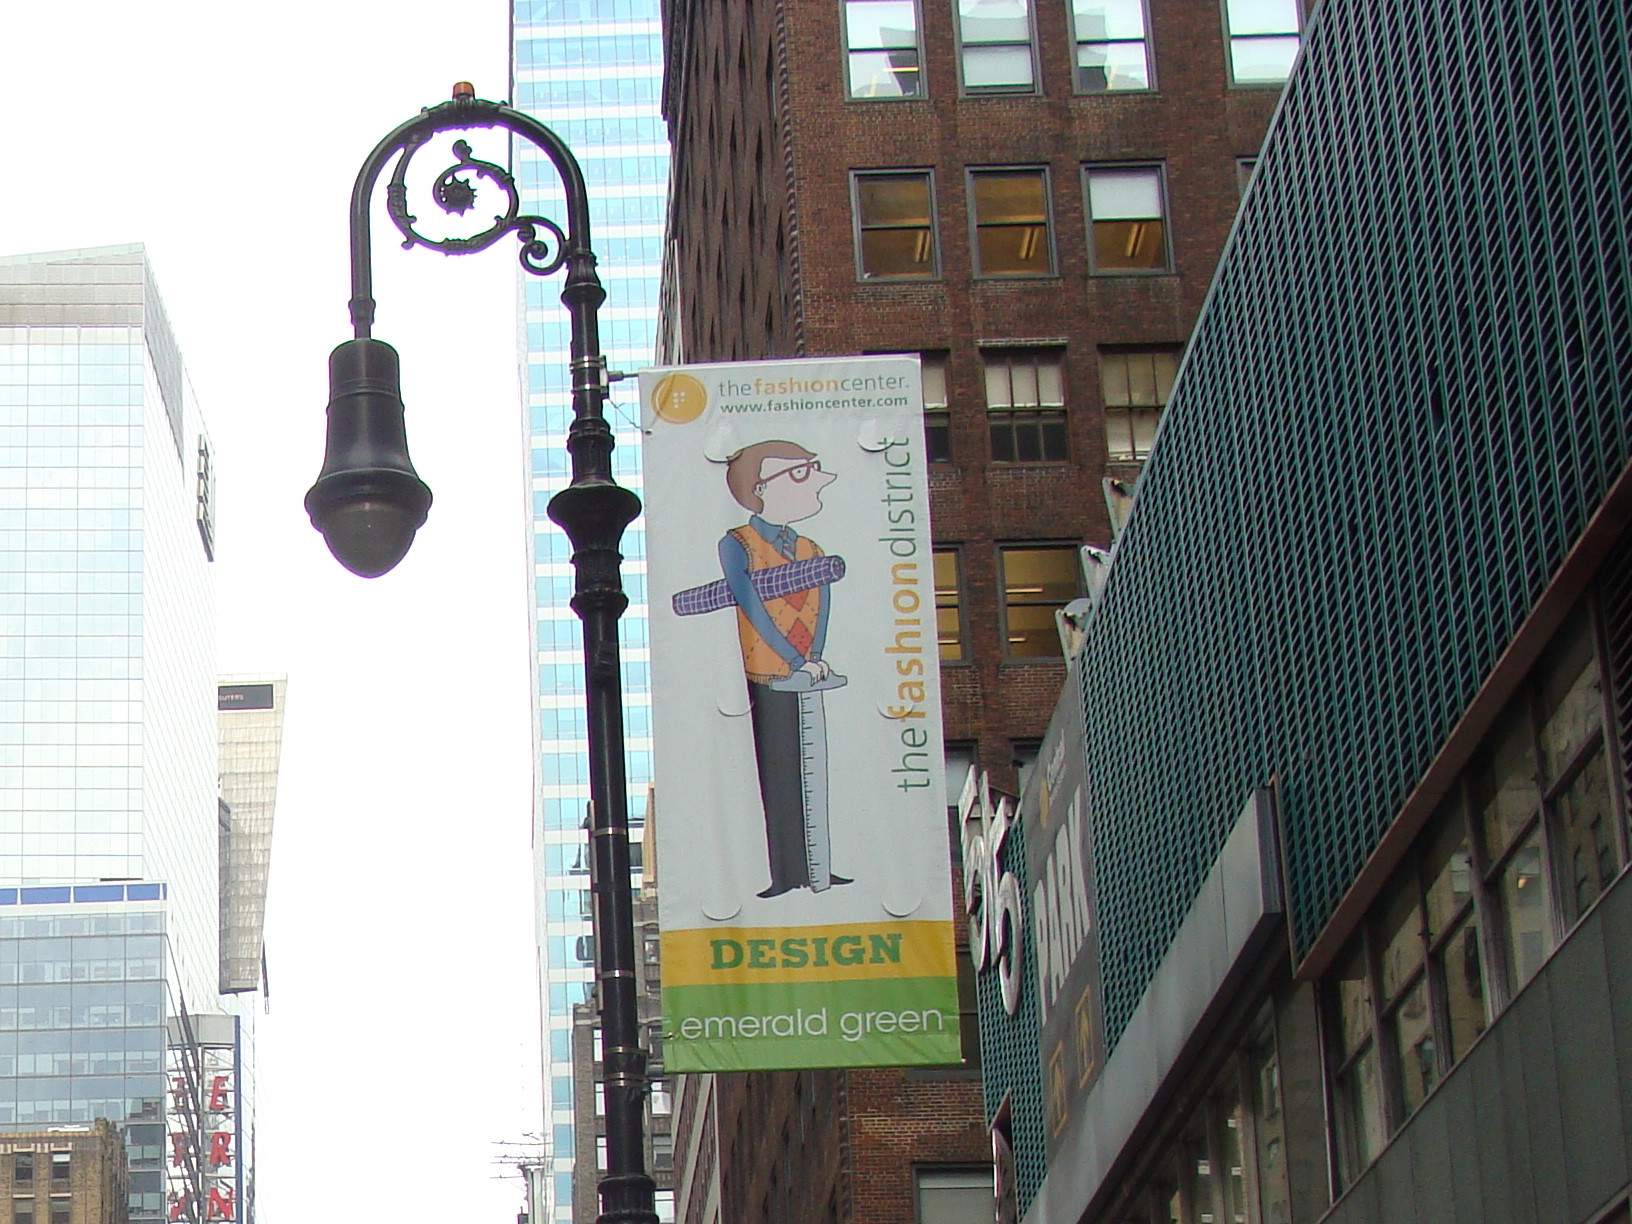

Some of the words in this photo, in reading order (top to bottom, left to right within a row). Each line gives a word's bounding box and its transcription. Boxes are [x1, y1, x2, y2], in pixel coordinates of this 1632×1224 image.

[719, 394, 908, 415] www.fashioncenter.com
[1033, 784, 1090, 1027] PARK
[709, 933, 903, 969] DESIGN
[681, 1009, 829, 1041] emerald
[839, 1004, 943, 1043] green
